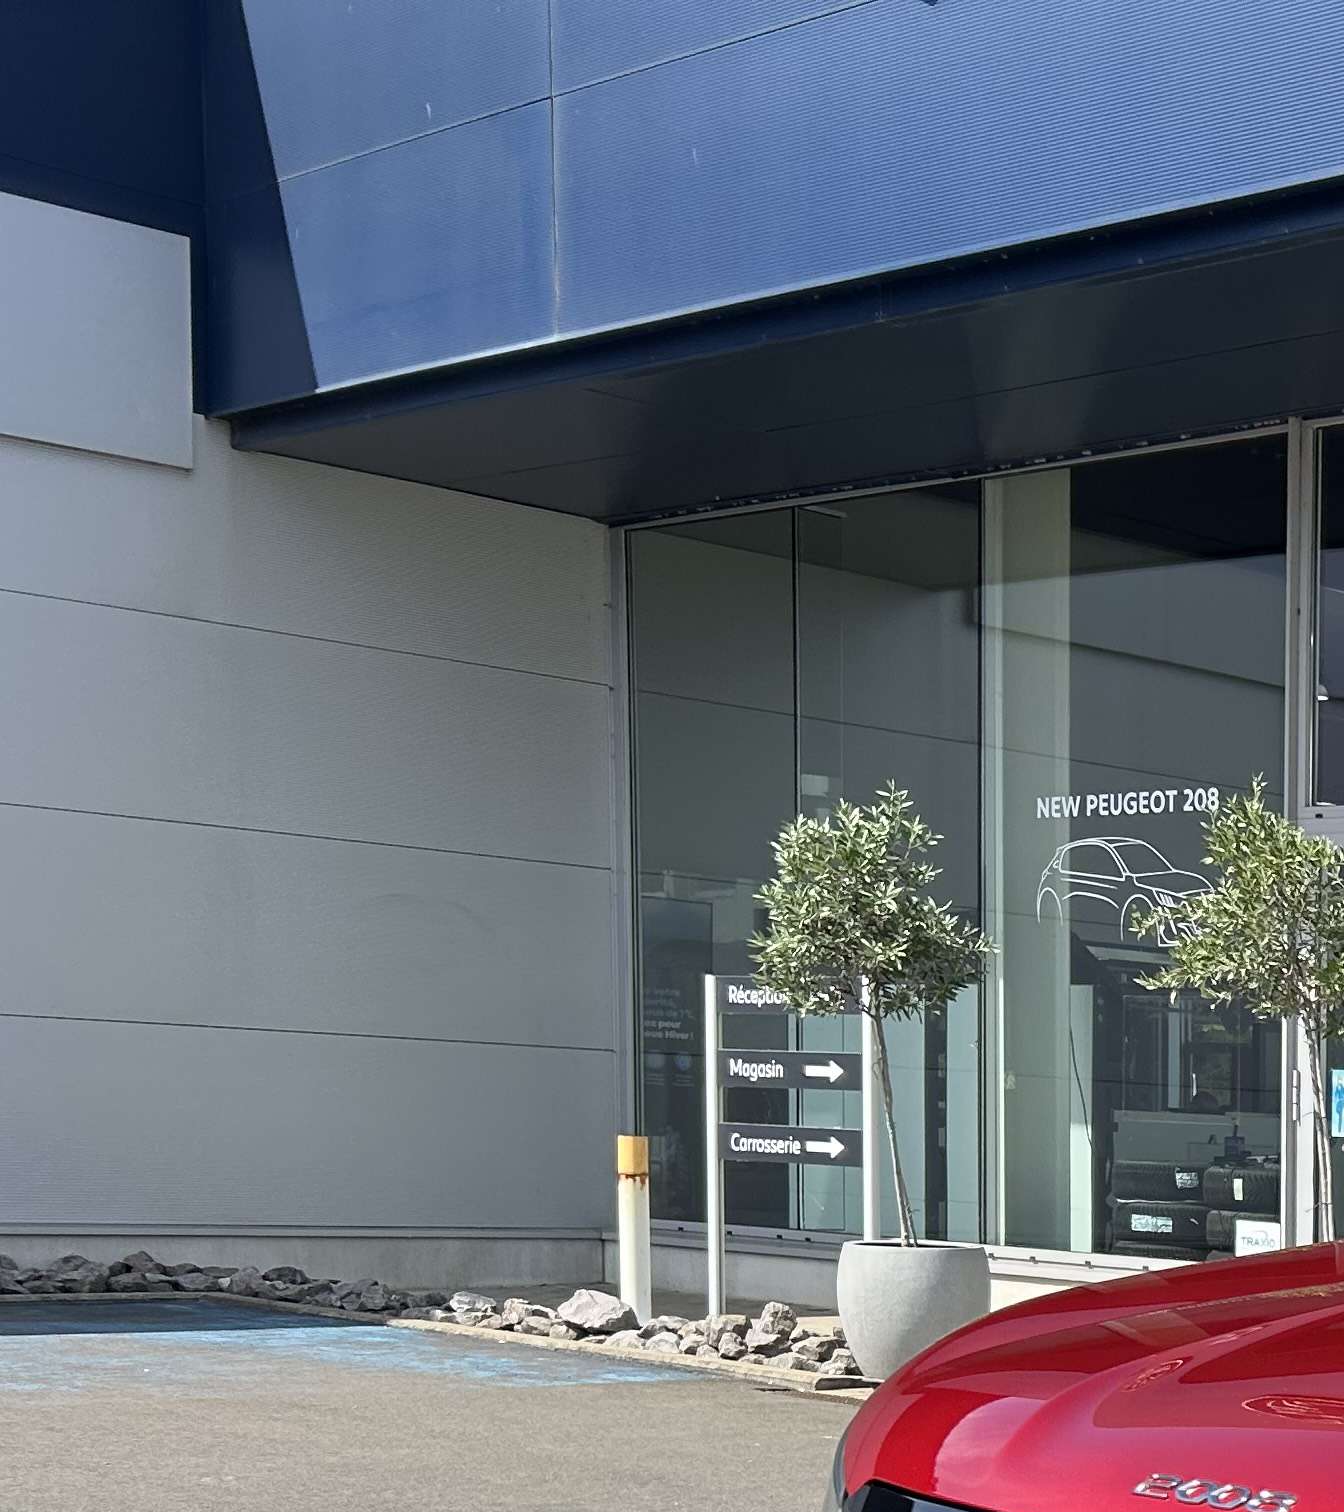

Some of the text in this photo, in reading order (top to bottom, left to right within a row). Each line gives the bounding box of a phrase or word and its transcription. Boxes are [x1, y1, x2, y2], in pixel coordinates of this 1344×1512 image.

[1036, 787, 1220, 818] NEW PEUGEOT 208
[728, 984, 790, 1007] Réceptio
[729, 1058, 784, 1081] Magasin
[730, 1132, 801, 1154] Carrosserie
